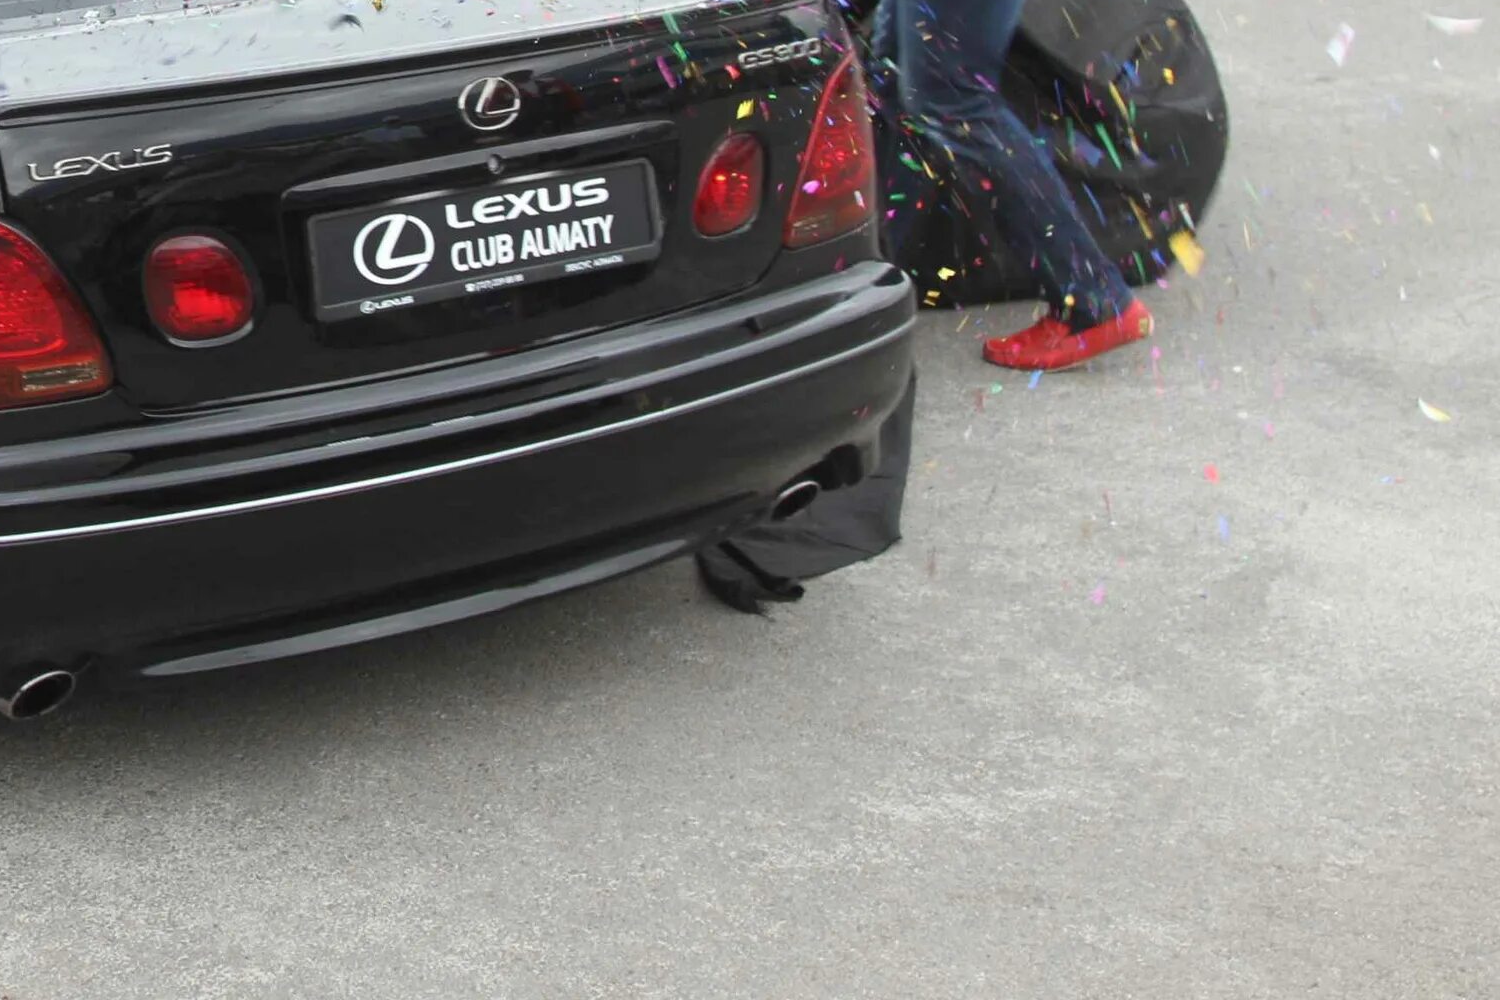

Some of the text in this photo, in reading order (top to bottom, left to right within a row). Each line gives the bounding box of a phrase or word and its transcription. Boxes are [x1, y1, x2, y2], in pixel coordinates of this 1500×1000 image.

[28, 143, 174, 183] LEXUS
[444, 177, 610, 230] LEXUS
[451, 233, 516, 272] CLUB
[520, 214, 615, 260] ALMATY
